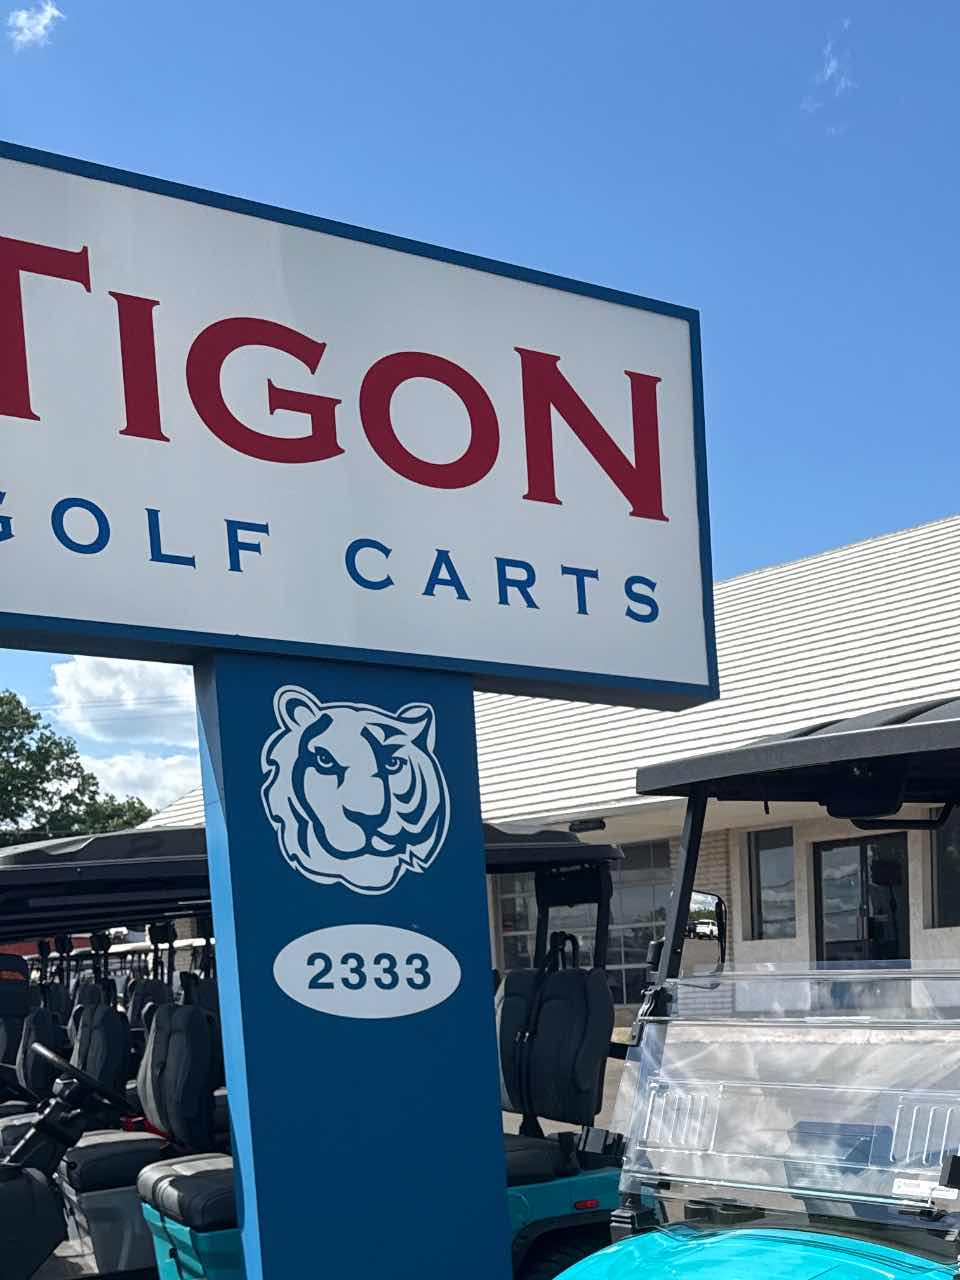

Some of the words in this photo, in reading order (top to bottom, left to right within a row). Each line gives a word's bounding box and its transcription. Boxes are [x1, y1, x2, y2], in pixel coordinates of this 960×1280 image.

[0, 490, 270, 574] OLF
[344, 537, 661, 625] CARTS
[306, 951, 432, 991] 2333
